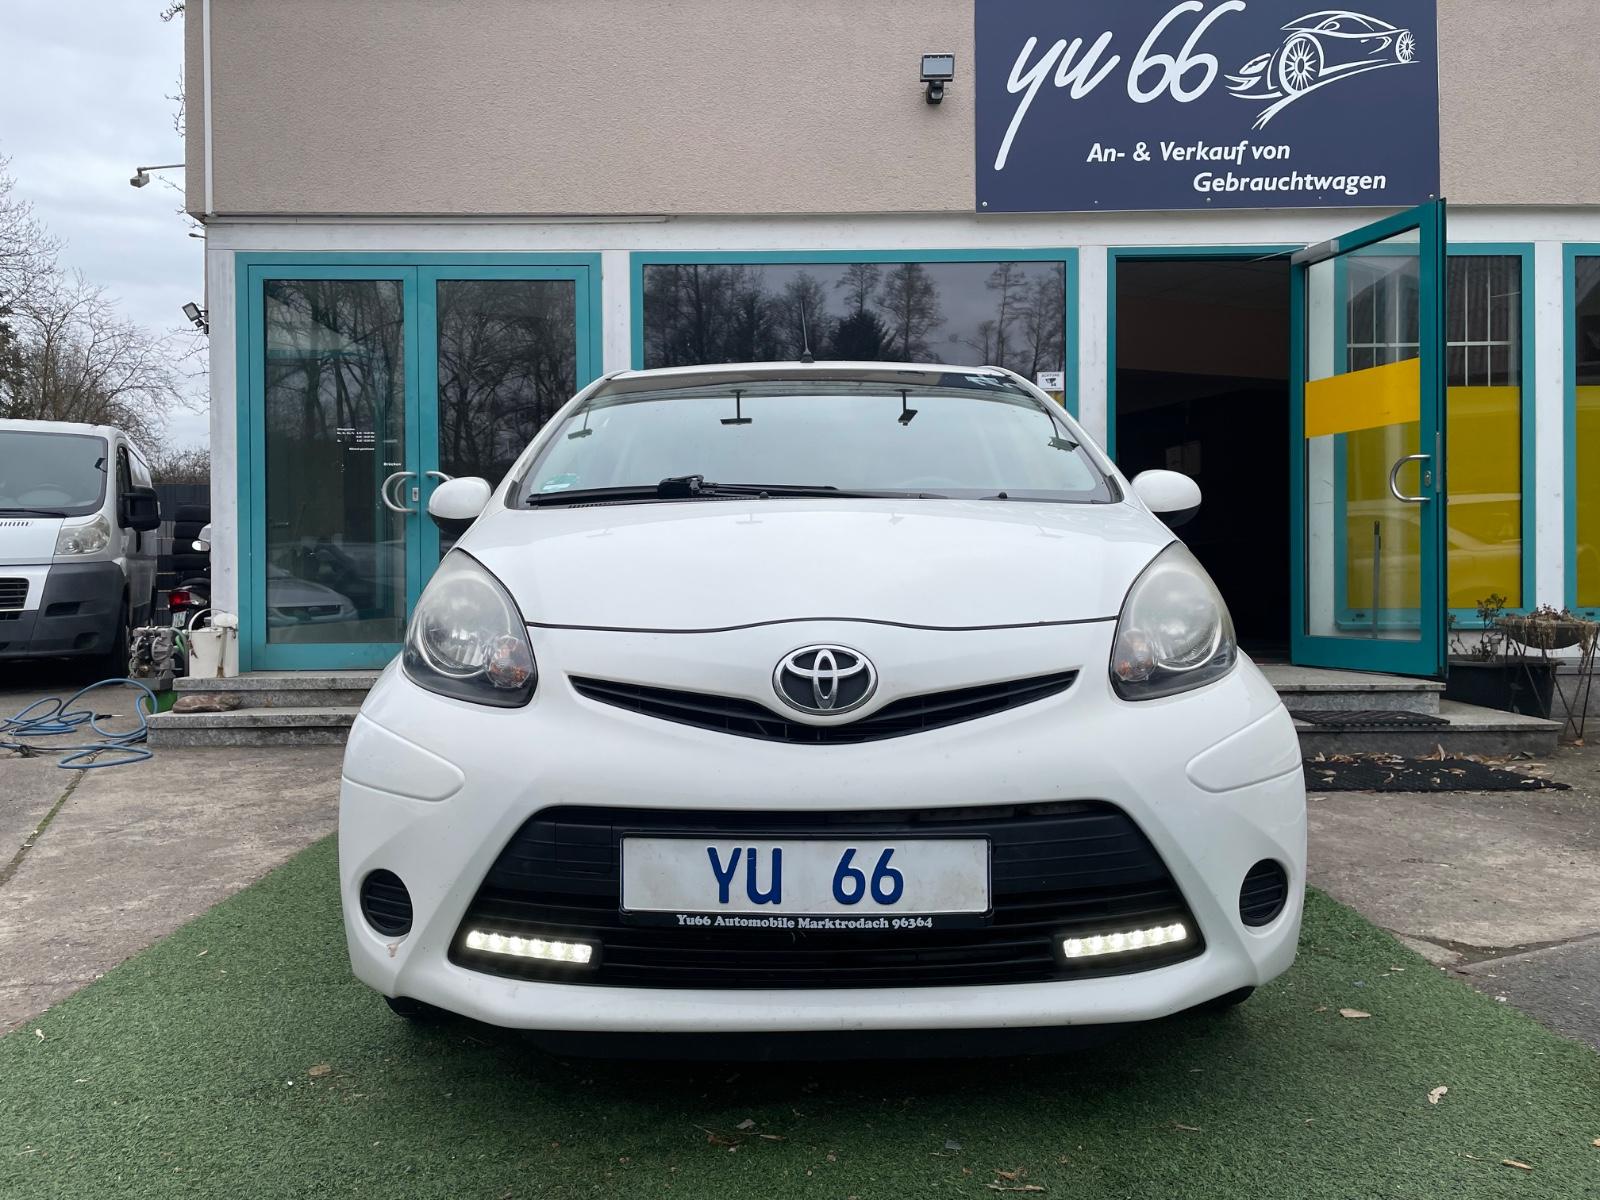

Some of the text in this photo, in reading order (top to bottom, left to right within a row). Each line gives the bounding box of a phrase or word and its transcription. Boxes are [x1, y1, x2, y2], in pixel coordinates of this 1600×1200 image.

[1127, 0, 1246, 104] 66
[1086, 141, 1291, 166] An- & Verkauf von
[1193, 170, 1386, 196] Gebrauchtwagen
[706, 846, 904, 906] YU 66
[676, 914, 933, 930] Yu66 Automobile Marktrodach 96364
